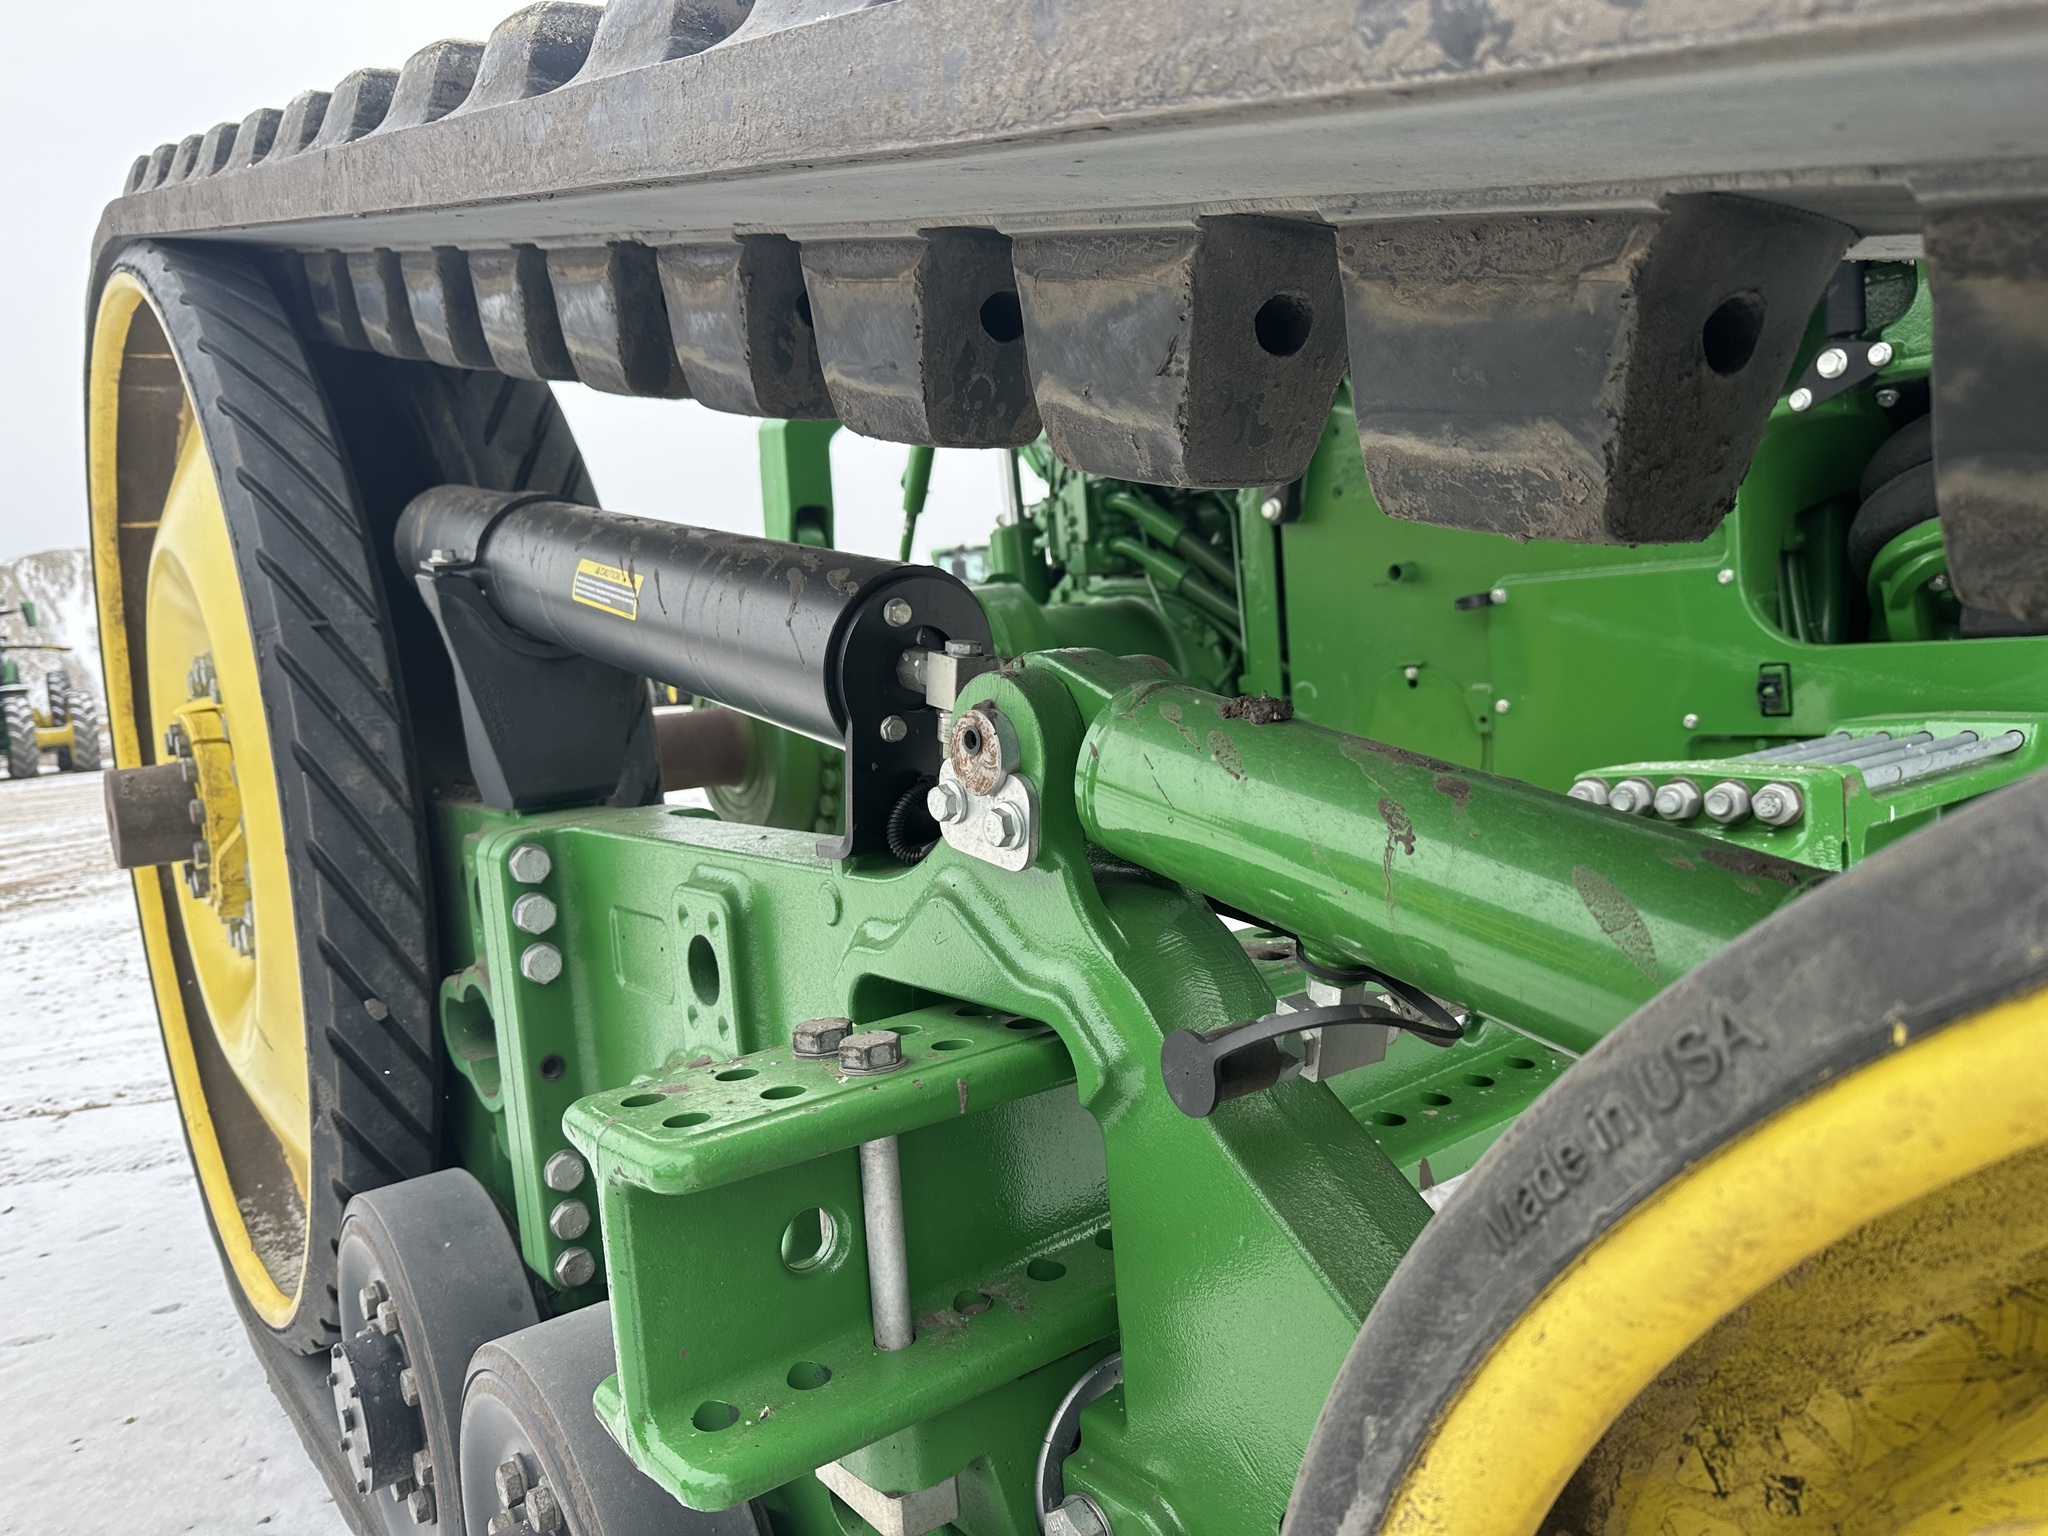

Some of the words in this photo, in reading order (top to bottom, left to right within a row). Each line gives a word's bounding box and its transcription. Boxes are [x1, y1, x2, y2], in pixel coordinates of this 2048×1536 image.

[600, 567, 621, 581] CAUTION
[1481, 1139, 1589, 1256] Made
[1584, 1091, 1644, 1155] in
[1636, 997, 1770, 1113] USA
